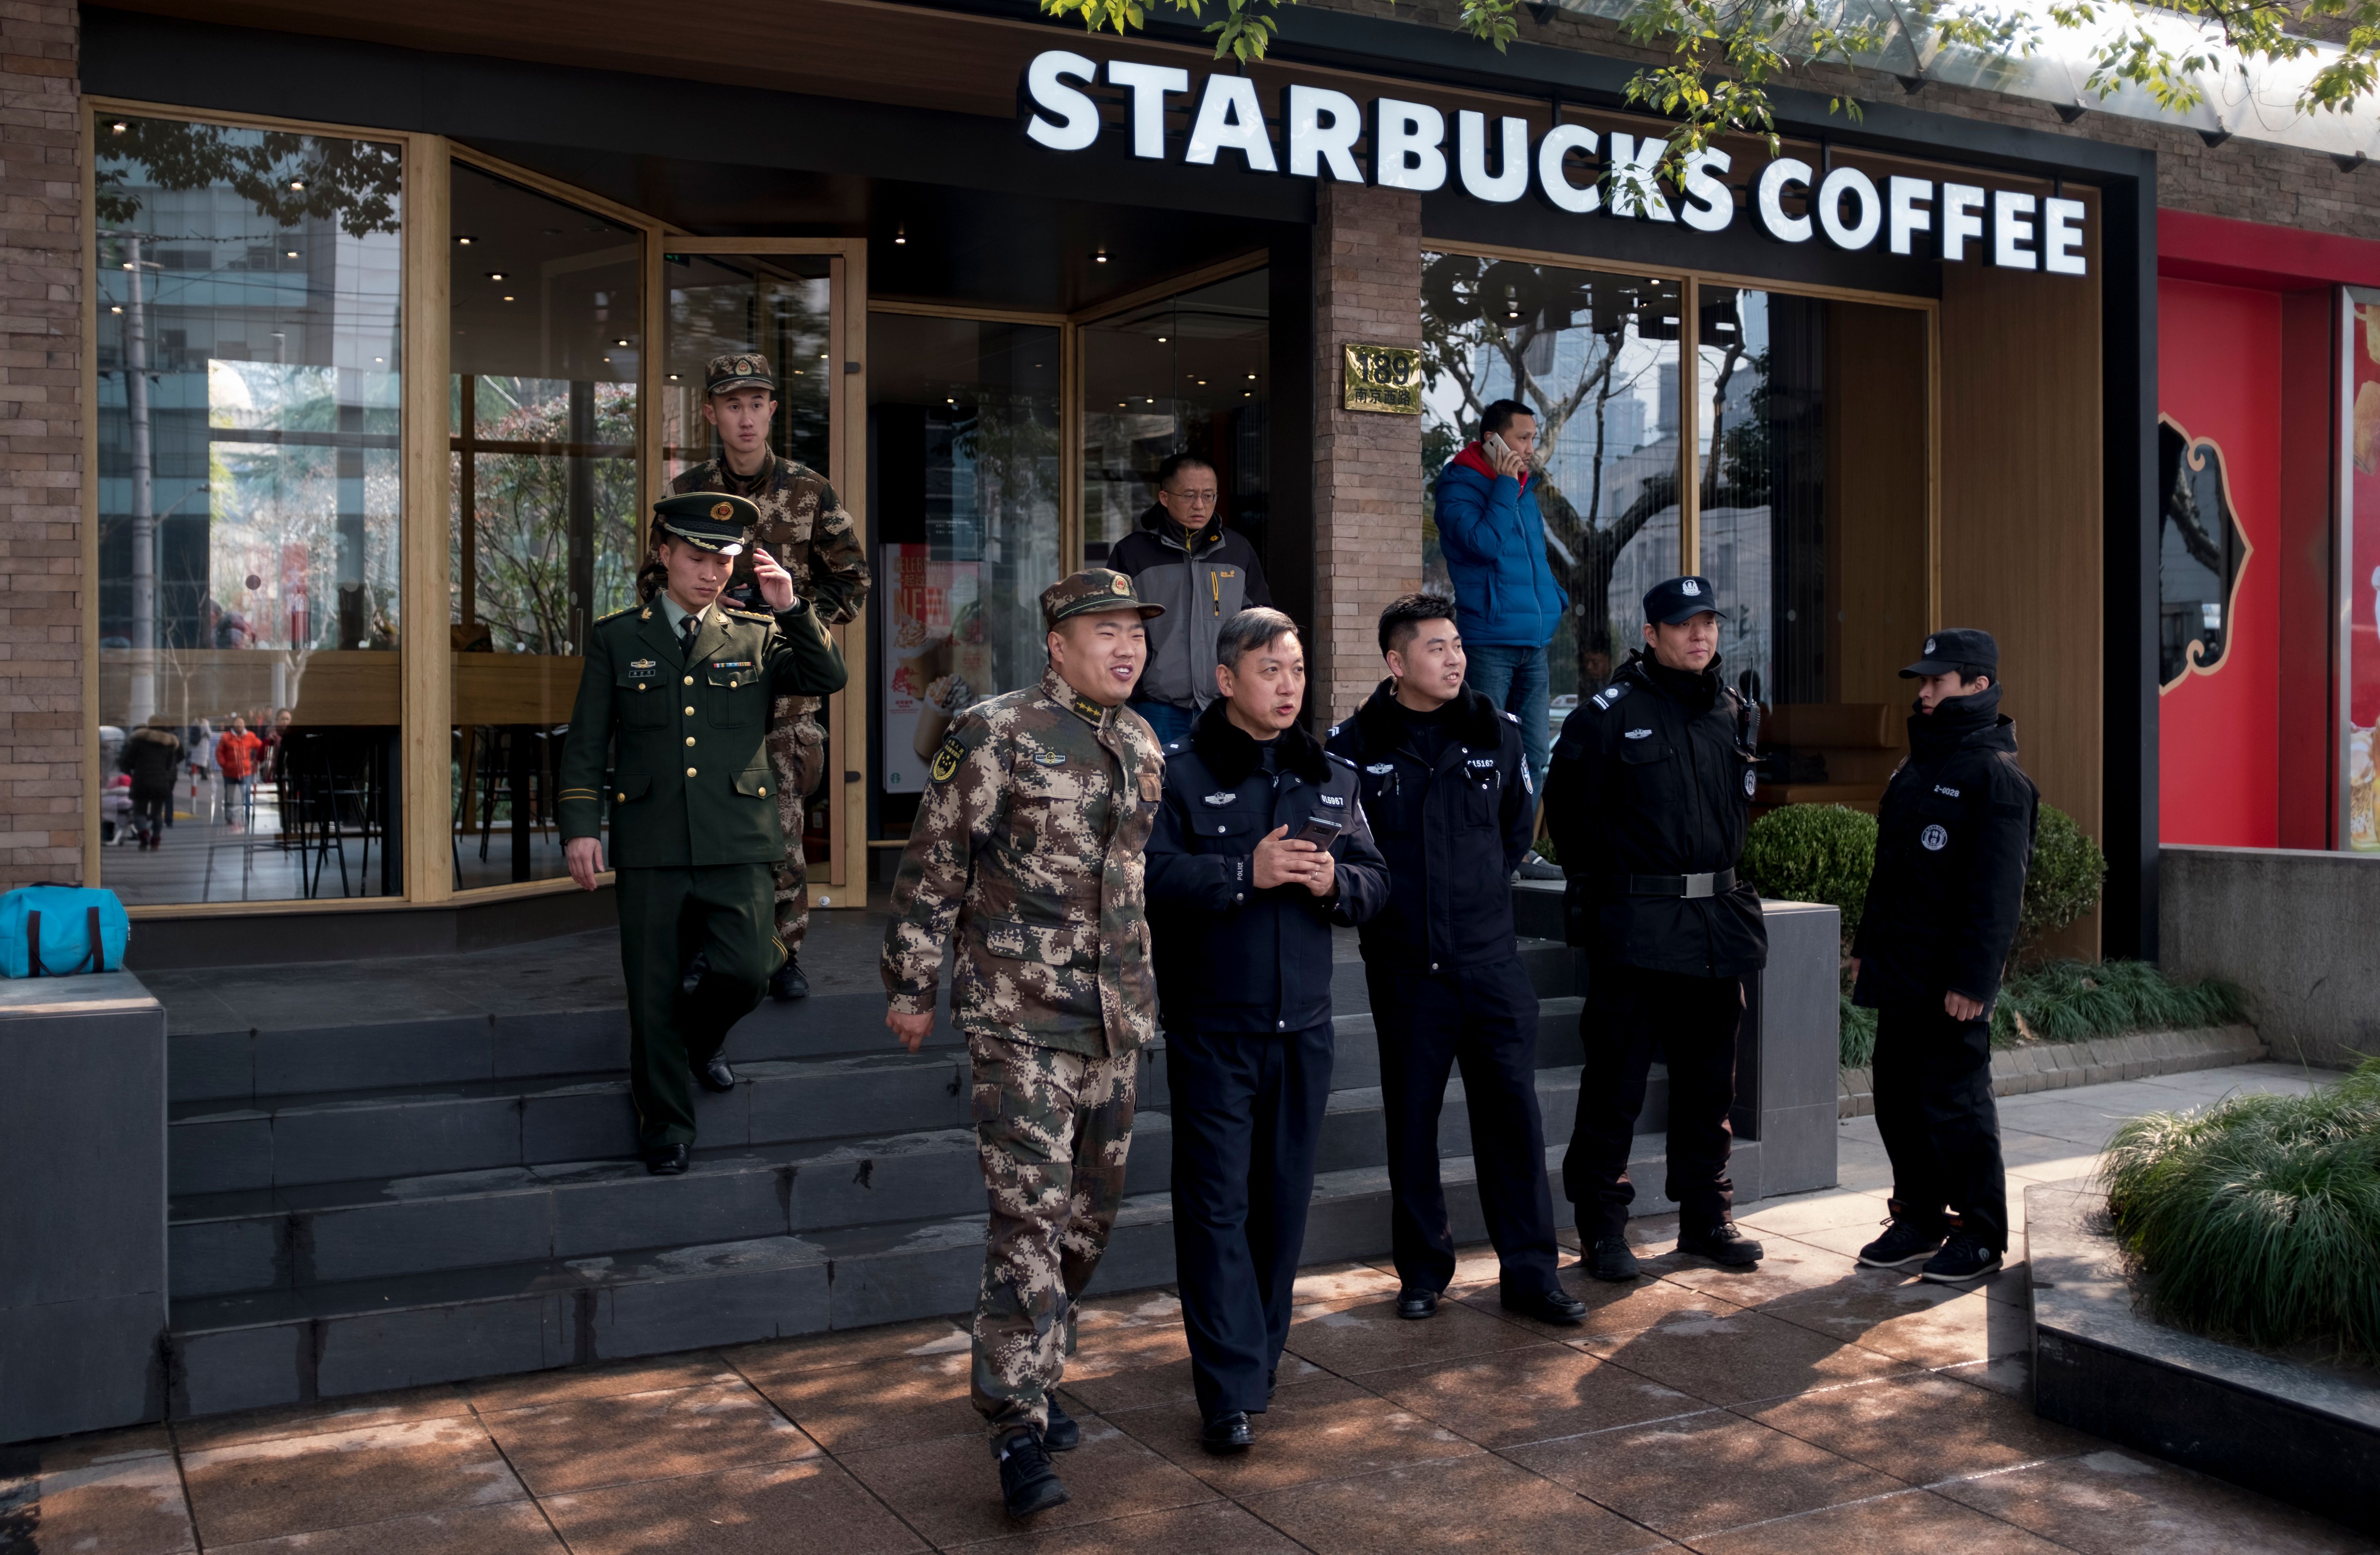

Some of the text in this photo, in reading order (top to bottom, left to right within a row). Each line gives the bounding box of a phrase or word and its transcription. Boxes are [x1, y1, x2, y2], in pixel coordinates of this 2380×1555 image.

[1026, 50, 2086, 274] STARBUCKS COFFEE
[1357, 353, 1409, 385] 189
[1355, 387, 1411, 406] 南京西路
[1321, 794, 1344, 805] 016967
[1934, 785, 1960, 797] 2-0028
